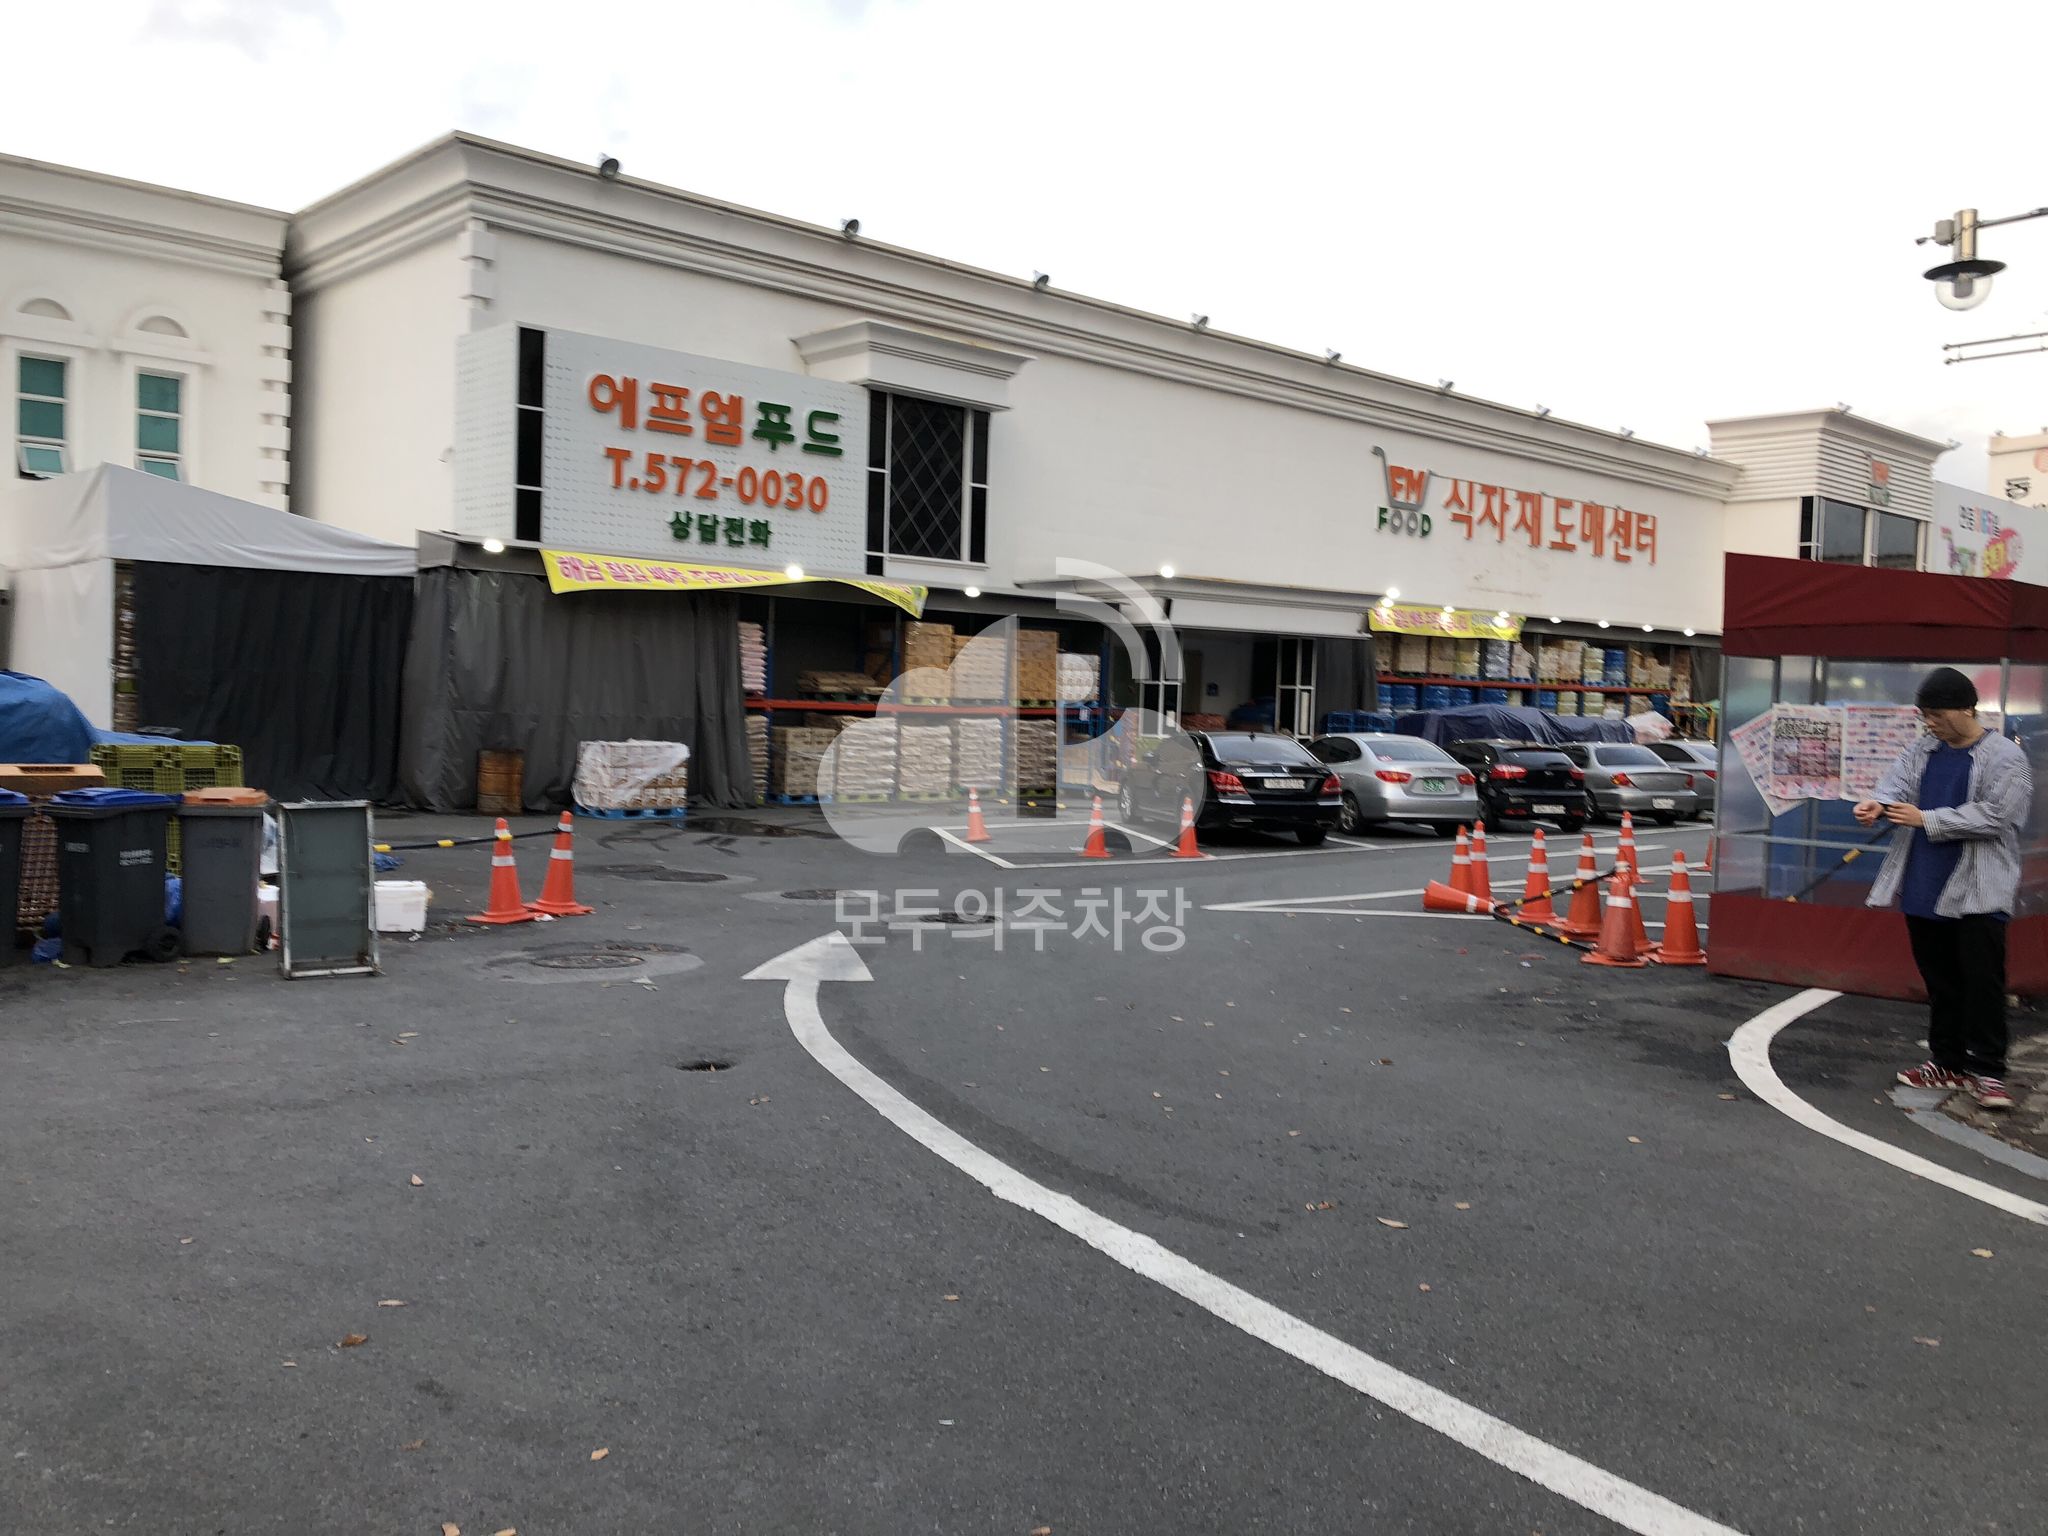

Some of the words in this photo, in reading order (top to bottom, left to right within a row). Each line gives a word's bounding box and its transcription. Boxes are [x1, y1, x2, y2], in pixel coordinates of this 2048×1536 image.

[588, 373, 844, 457] 에프엠푸드
[604, 446, 829, 514] T.572-0030
[1389, 464, 1425, 505] FM
[668, 511, 772, 548] 상담전화
[1376, 506, 1432, 538] FOOD
